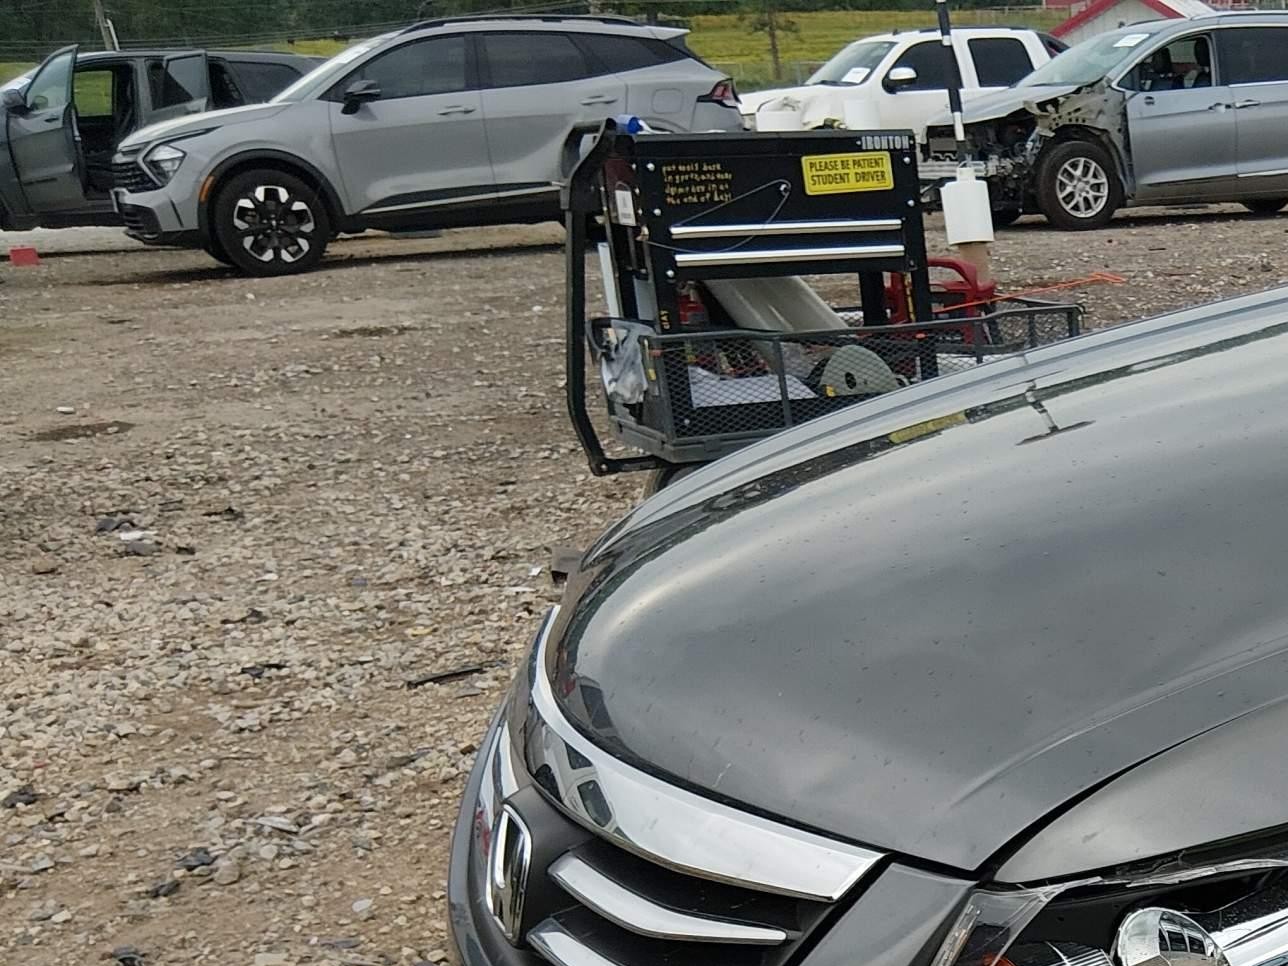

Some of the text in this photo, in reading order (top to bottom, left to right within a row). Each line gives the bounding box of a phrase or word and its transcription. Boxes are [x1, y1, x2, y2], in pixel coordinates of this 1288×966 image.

[861, 135, 909, 150] IRONTON
[809, 157, 885, 172] PLEASE BE PATIENT
[810, 171, 887, 186] STUDENT DRIVER
